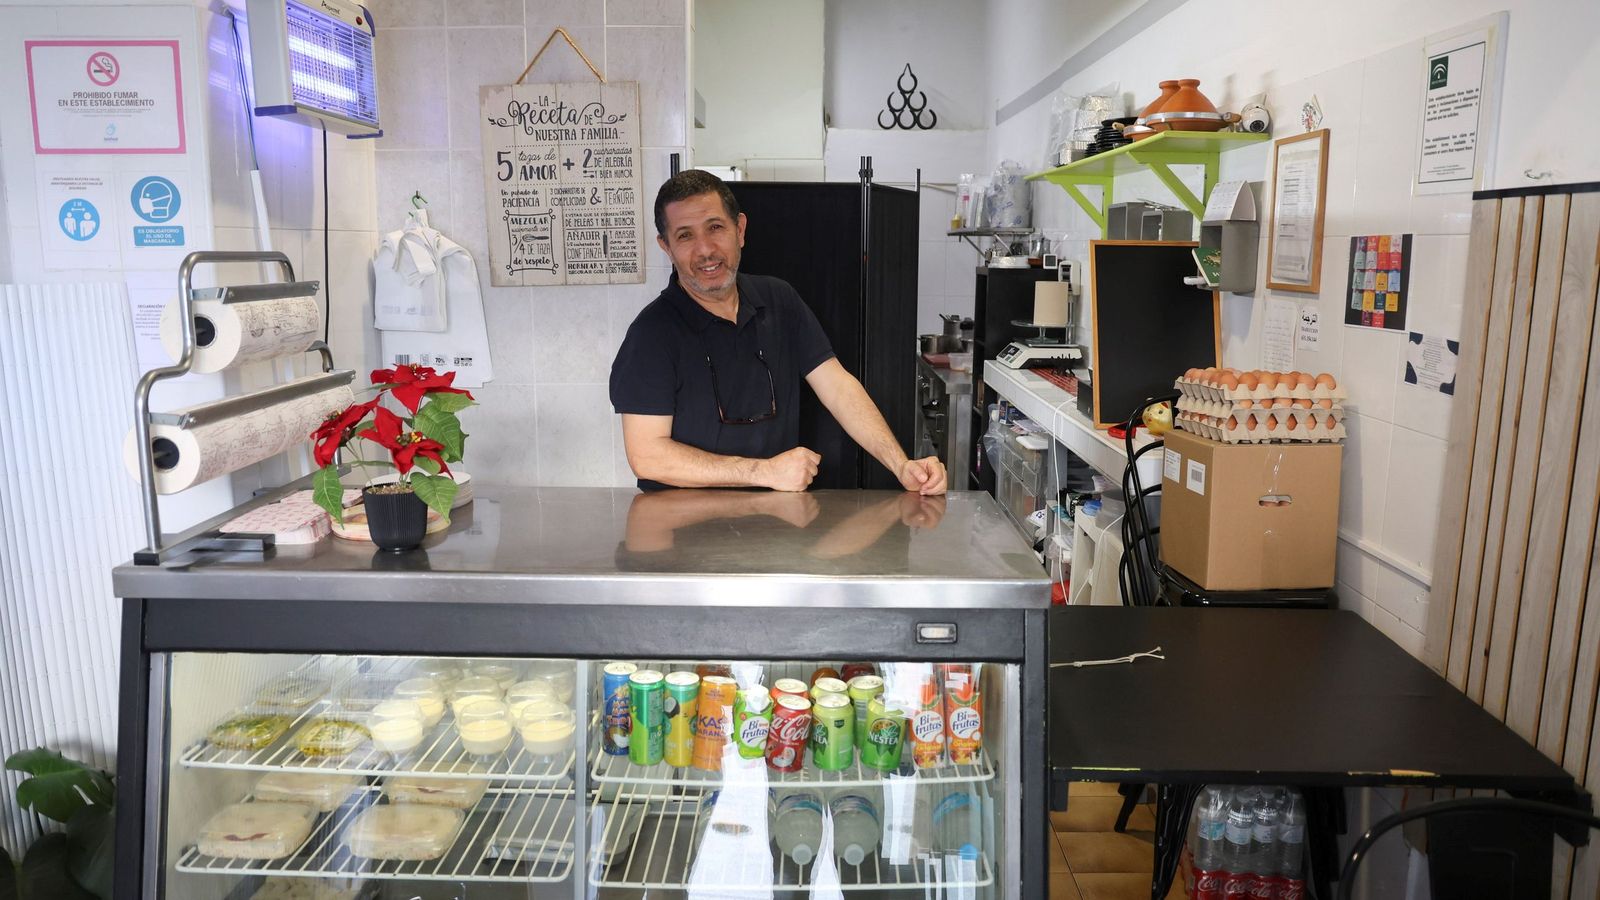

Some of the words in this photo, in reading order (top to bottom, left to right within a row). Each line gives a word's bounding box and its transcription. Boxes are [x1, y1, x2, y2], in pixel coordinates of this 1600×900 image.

[539, 96, 549, 106] LA
[508, 101, 599, 135] Receta
[584, 114, 592, 125] DE
[535, 128, 577, 141] NUESTRA
[518, 150, 541, 165] tazas
[544, 148, 556, 160] de
[582, 148, 594, 168] 2
[594, 157, 602, 168] DE
[605, 155, 633, 168] ALEGRÍA
[497, 151, 513, 181] 5
[520, 164, 557, 180] AMOR
[600, 170, 612, 178] BUEN
[614, 169, 633, 178] HUMOR
[550, 197, 586, 206] COMPLICIDAD
[590, 187, 602, 205] &
[605, 192, 634, 205] TERNURA
[502, 198, 540, 208] PACIENCIA
[510, 217, 549, 225] MEZCLAR
[565, 219, 571, 227] DE
[574, 218, 594, 227] PELEAS
[601, 218, 612, 226] MAL
[614, 217, 635, 226] HUMOR
[567, 230, 600, 240] AÑADIR
[615, 230, 636, 238] AMASAR
[528, 244, 534, 255] DE
[537, 243, 550, 255] TAZA
[567, 248, 602, 259] CONFIANZA
[524, 257, 551, 267] respeto
[920, 714, 930, 726] Bi
[957, 711, 967, 722] Bi
[749, 720, 758, 730] Bi
[915, 722, 942, 735] frutas
[952, 719, 979, 731] frutas
[742, 728, 768, 738] frutas
[868, 732, 898, 745] NESTEA
